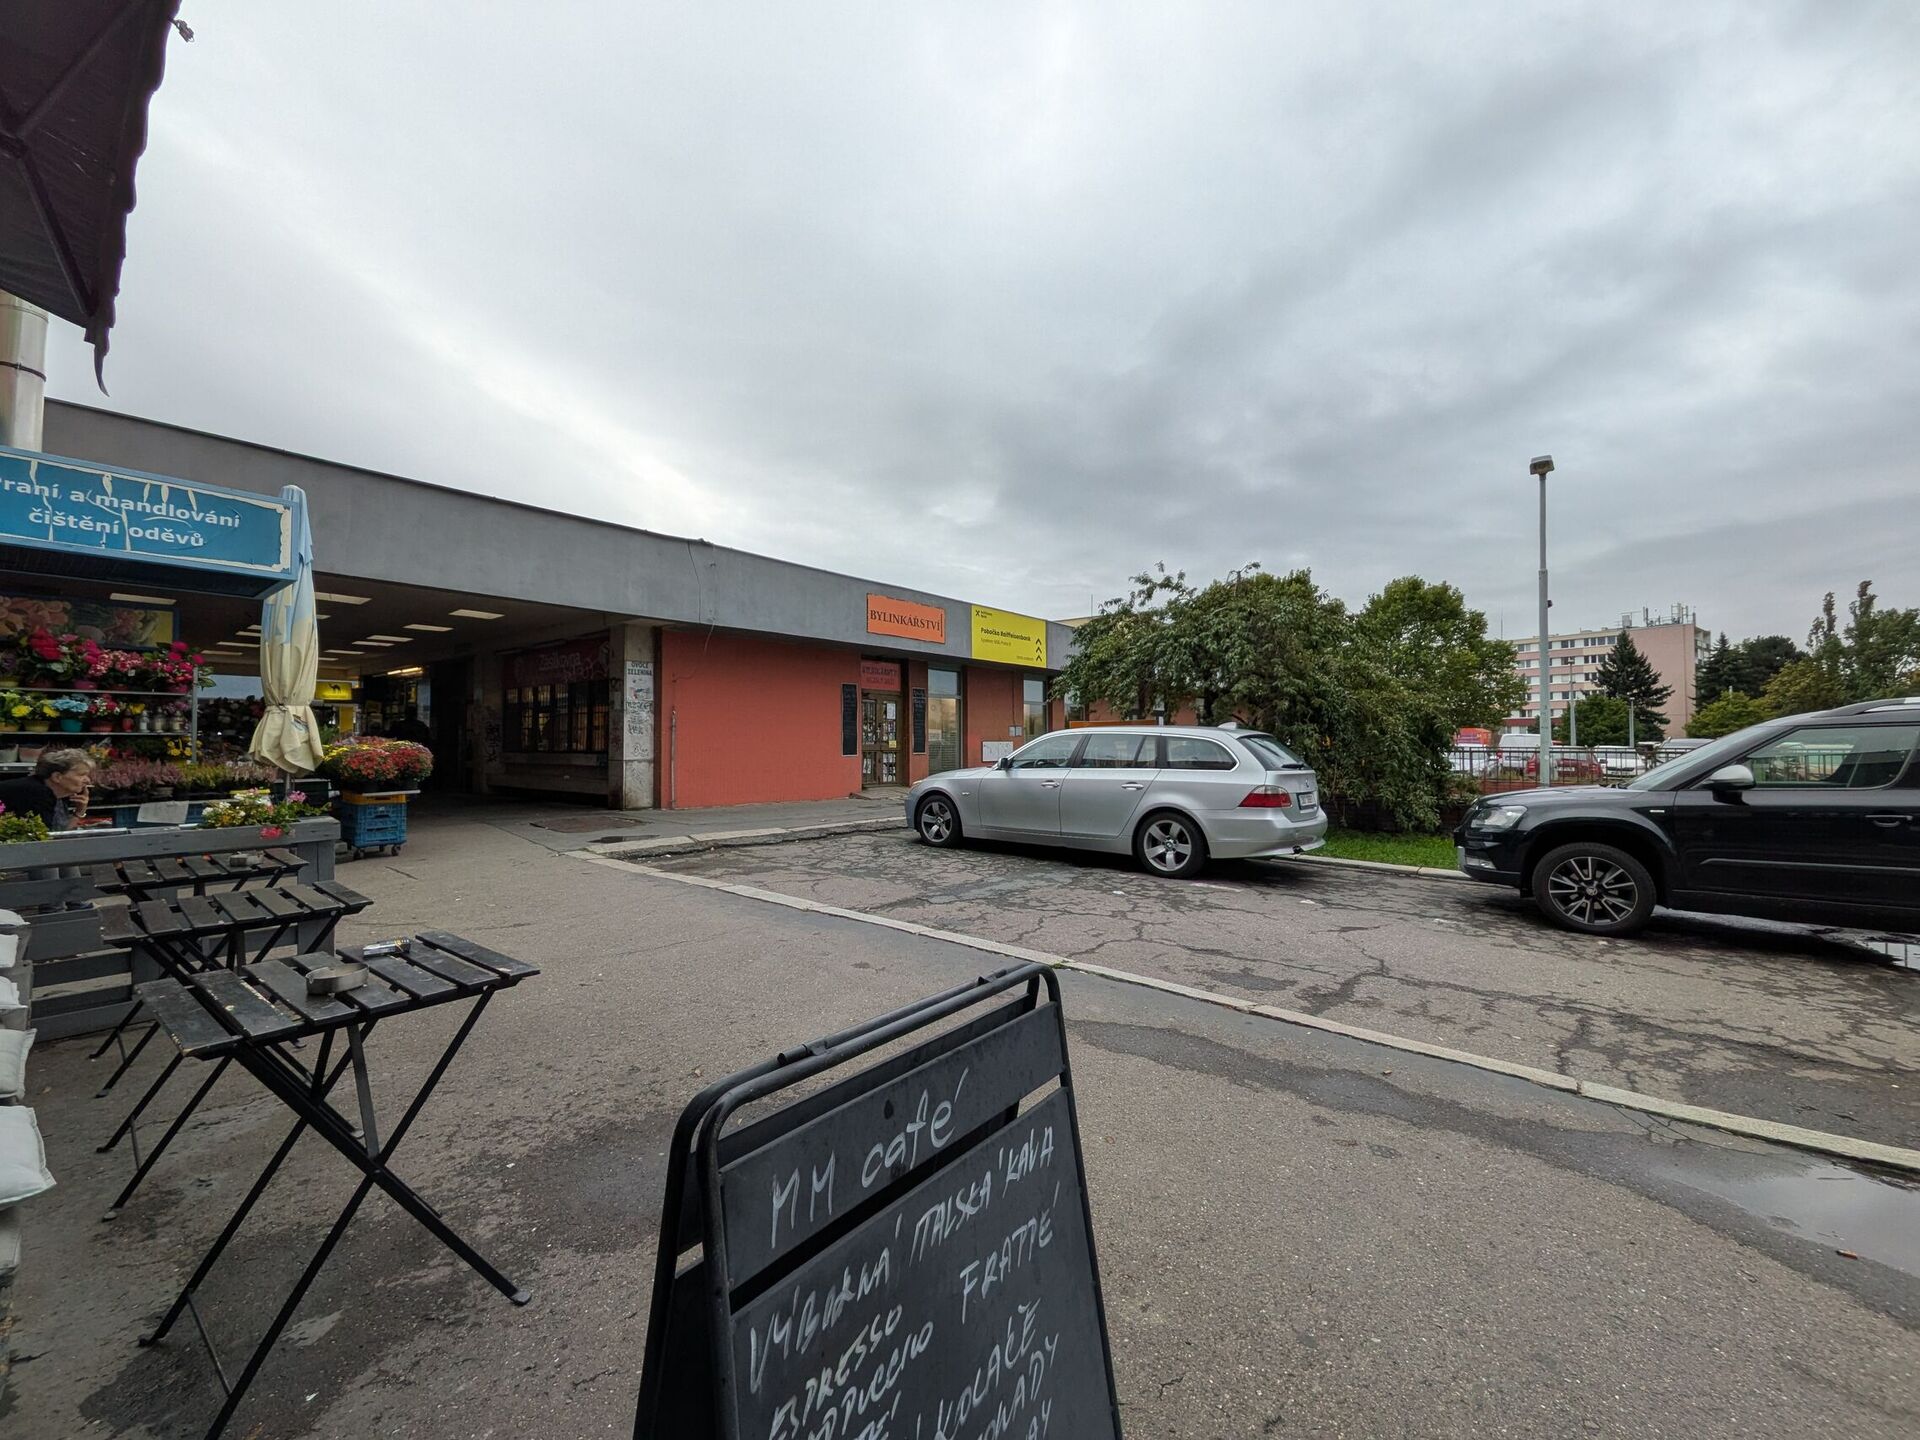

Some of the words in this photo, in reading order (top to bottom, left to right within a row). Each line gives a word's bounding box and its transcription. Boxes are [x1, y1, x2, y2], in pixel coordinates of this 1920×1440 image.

[0, 478, 60, 498] raní
[70, 491, 85, 502] a
[95, 494, 240, 528] mandlování
[28, 507, 119, 534] čištění
[128, 526, 204, 547] oděvů
